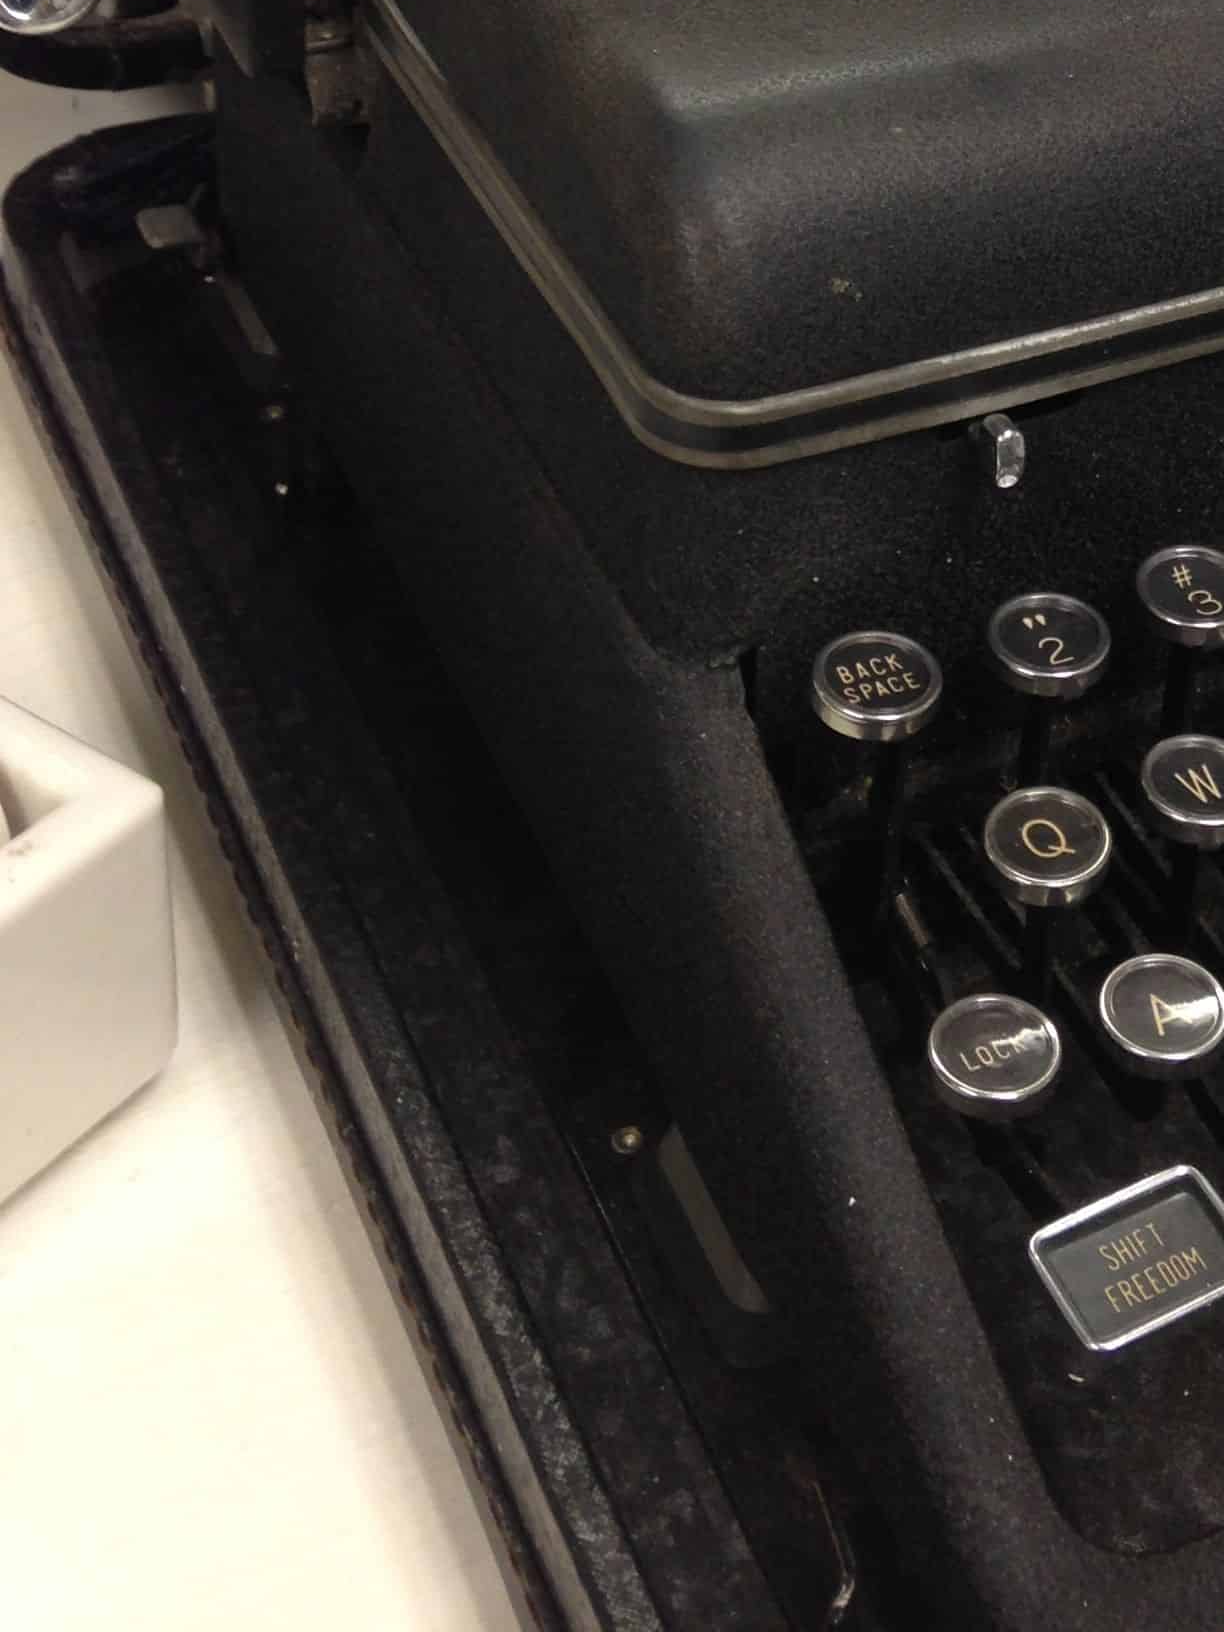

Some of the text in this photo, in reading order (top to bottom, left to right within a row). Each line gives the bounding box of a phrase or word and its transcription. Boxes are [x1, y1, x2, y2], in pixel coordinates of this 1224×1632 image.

[1172, 564, 1193, 588] #
[1187, 589, 1223, 616] 3
[835, 653, 906, 684] BACK
[1038, 636, 1075, 665] 2
[843, 672, 921, 705] SPACE
[1174, 764, 1222, 803] W
[1021, 818, 1076, 858] Q
[1150, 994, 1194, 1036] A
[959, 1034, 1025, 1072] LOCK
[1098, 1222, 1167, 1273] SHIFT
[1104, 1246, 1208, 1313] FREEDOM
